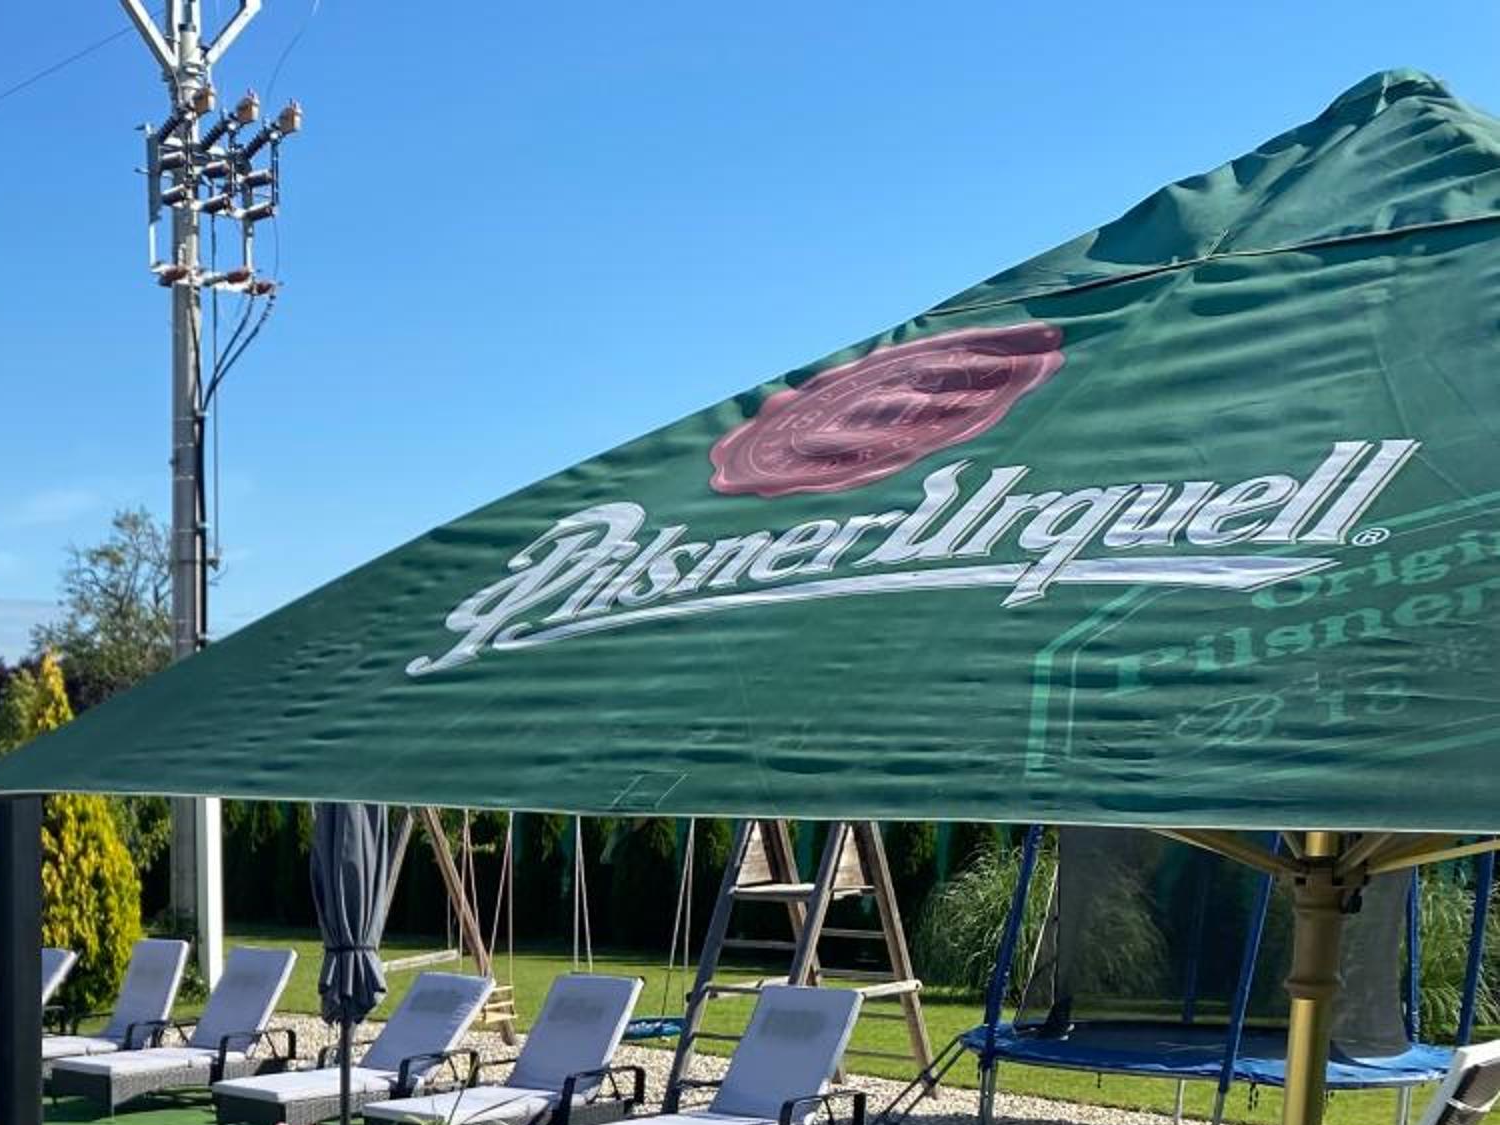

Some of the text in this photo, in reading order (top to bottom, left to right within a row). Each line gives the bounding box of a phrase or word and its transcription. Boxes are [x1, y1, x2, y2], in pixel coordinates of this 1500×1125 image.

[405, 438, 1422, 677] Pilsner Urquell
[1251, 529, 1500, 610] Origi
